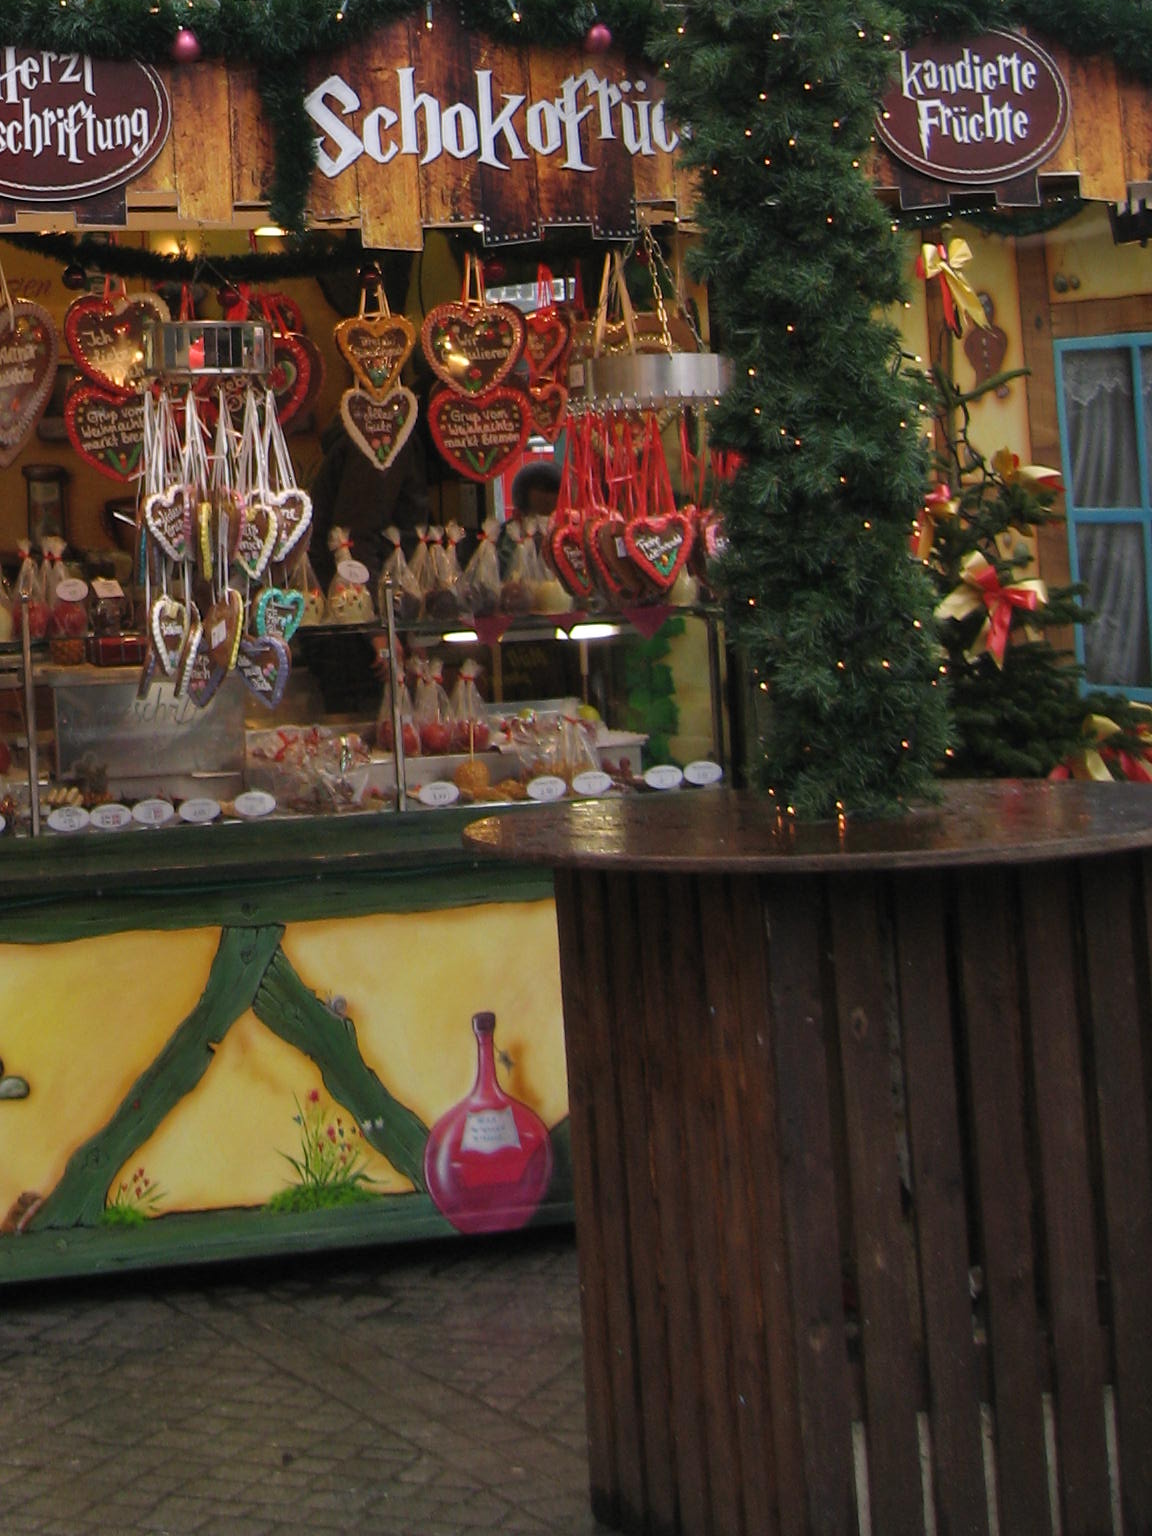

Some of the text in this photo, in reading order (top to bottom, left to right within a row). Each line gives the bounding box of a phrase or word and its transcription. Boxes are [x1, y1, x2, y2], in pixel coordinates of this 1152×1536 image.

[899, 48, 1036, 101] kandierte
[303, 66, 693, 180] Schokofrüc
[917, 94, 1030, 160] Früchte
[82, 331, 114, 347] Ich
